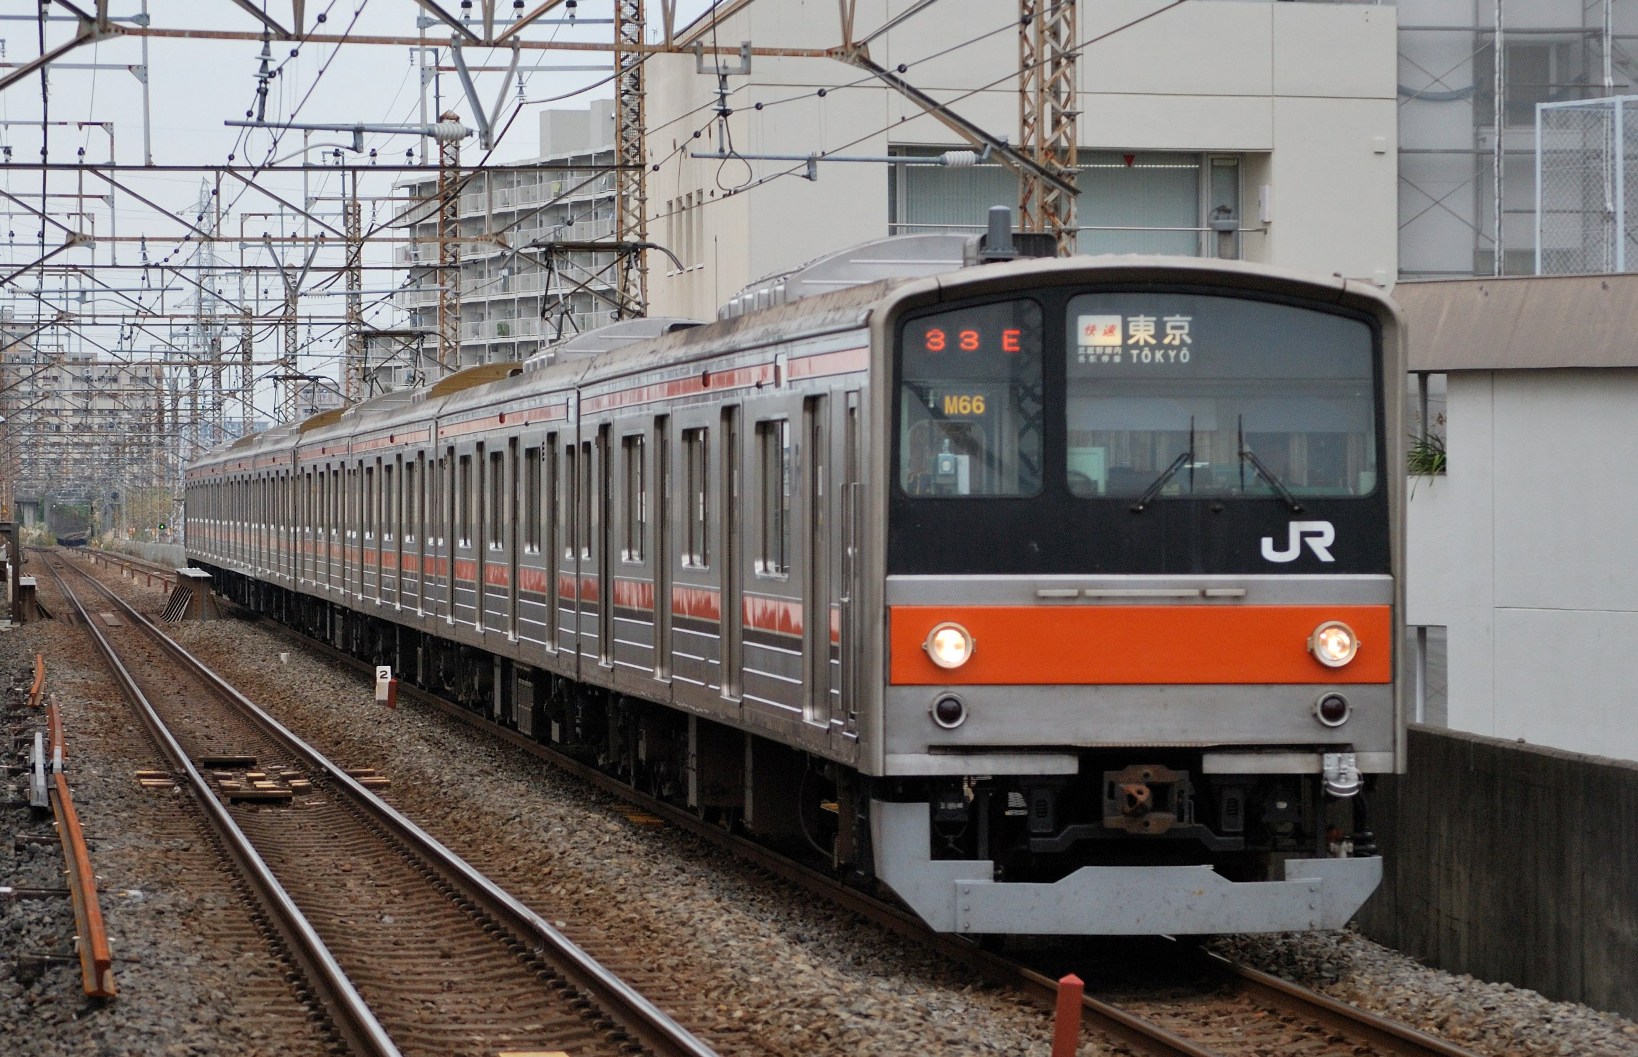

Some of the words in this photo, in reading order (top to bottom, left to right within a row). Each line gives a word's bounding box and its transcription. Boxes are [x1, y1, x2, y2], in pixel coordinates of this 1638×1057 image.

[1127, 314, 1192, 346] 東京
[944, 395, 985, 415] M66
[1261, 520, 1336, 563] JR
[380, 670, 388, 679] 2
